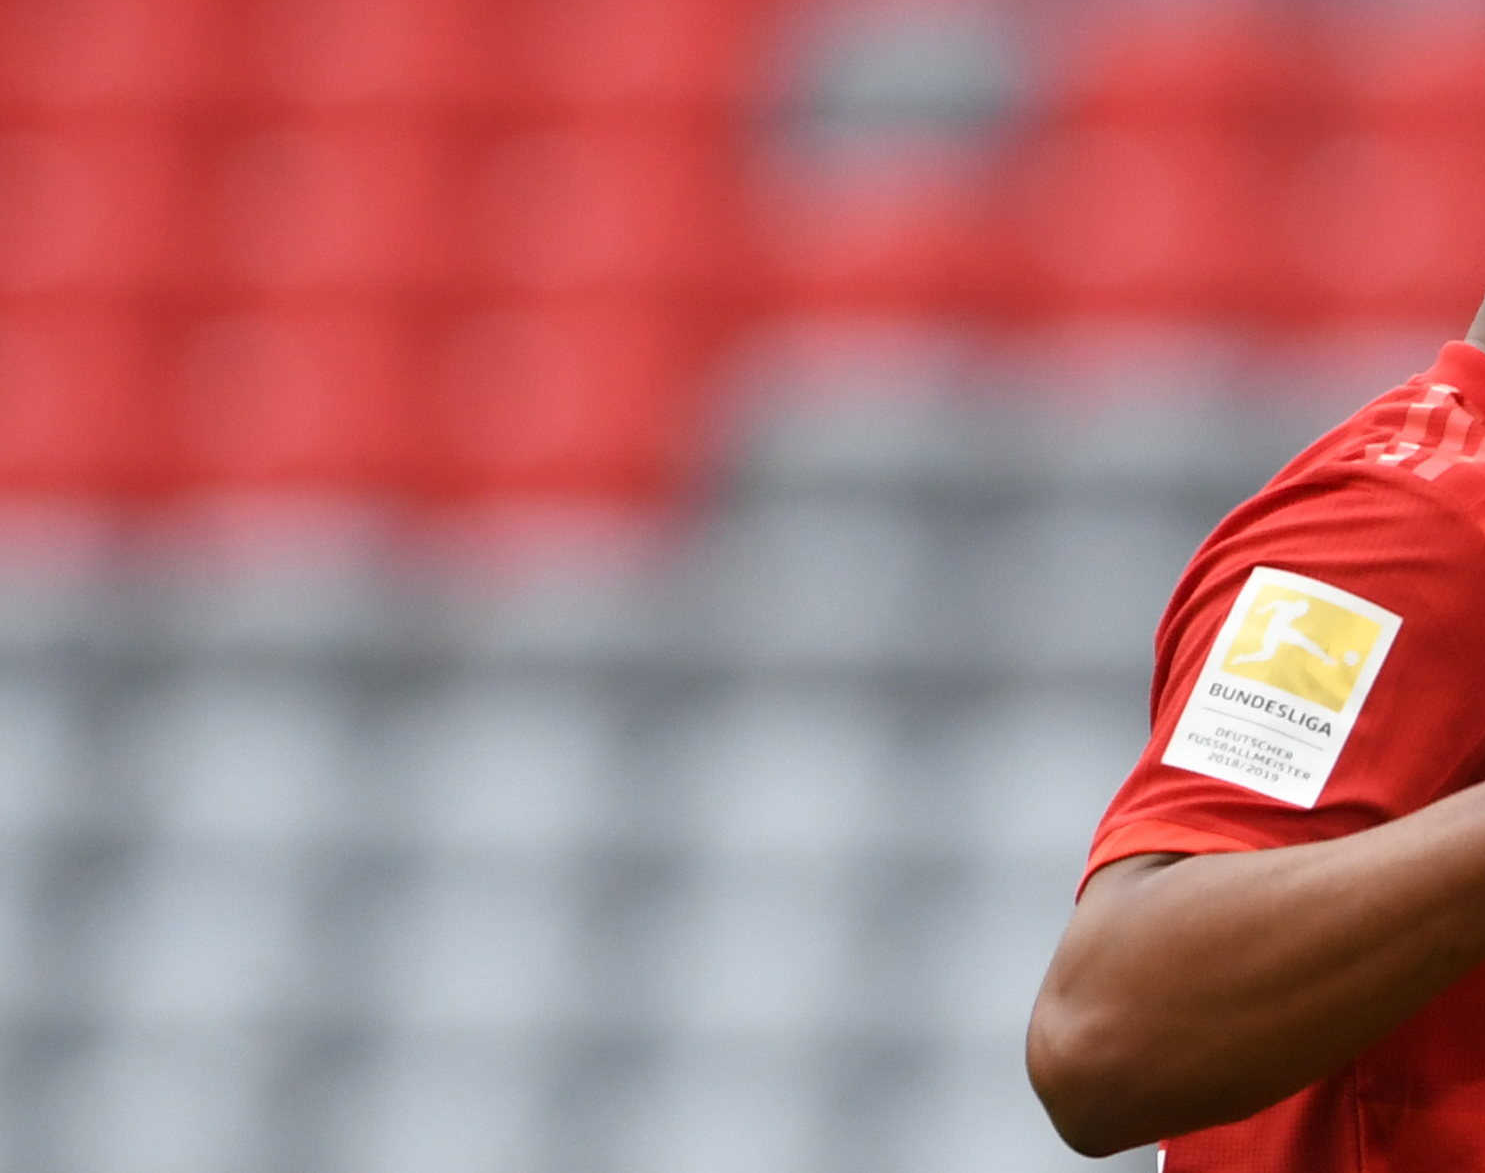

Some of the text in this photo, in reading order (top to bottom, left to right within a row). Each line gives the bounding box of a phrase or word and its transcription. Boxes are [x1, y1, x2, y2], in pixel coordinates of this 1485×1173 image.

[1208, 682, 1332, 737] BUNDESLIGA
[1187, 732, 1312, 781] FUSSBALLMEISTER
[1214, 726, 1294, 762] DEUTSCHER
[1206, 752, 1280, 783] 2018/2019
